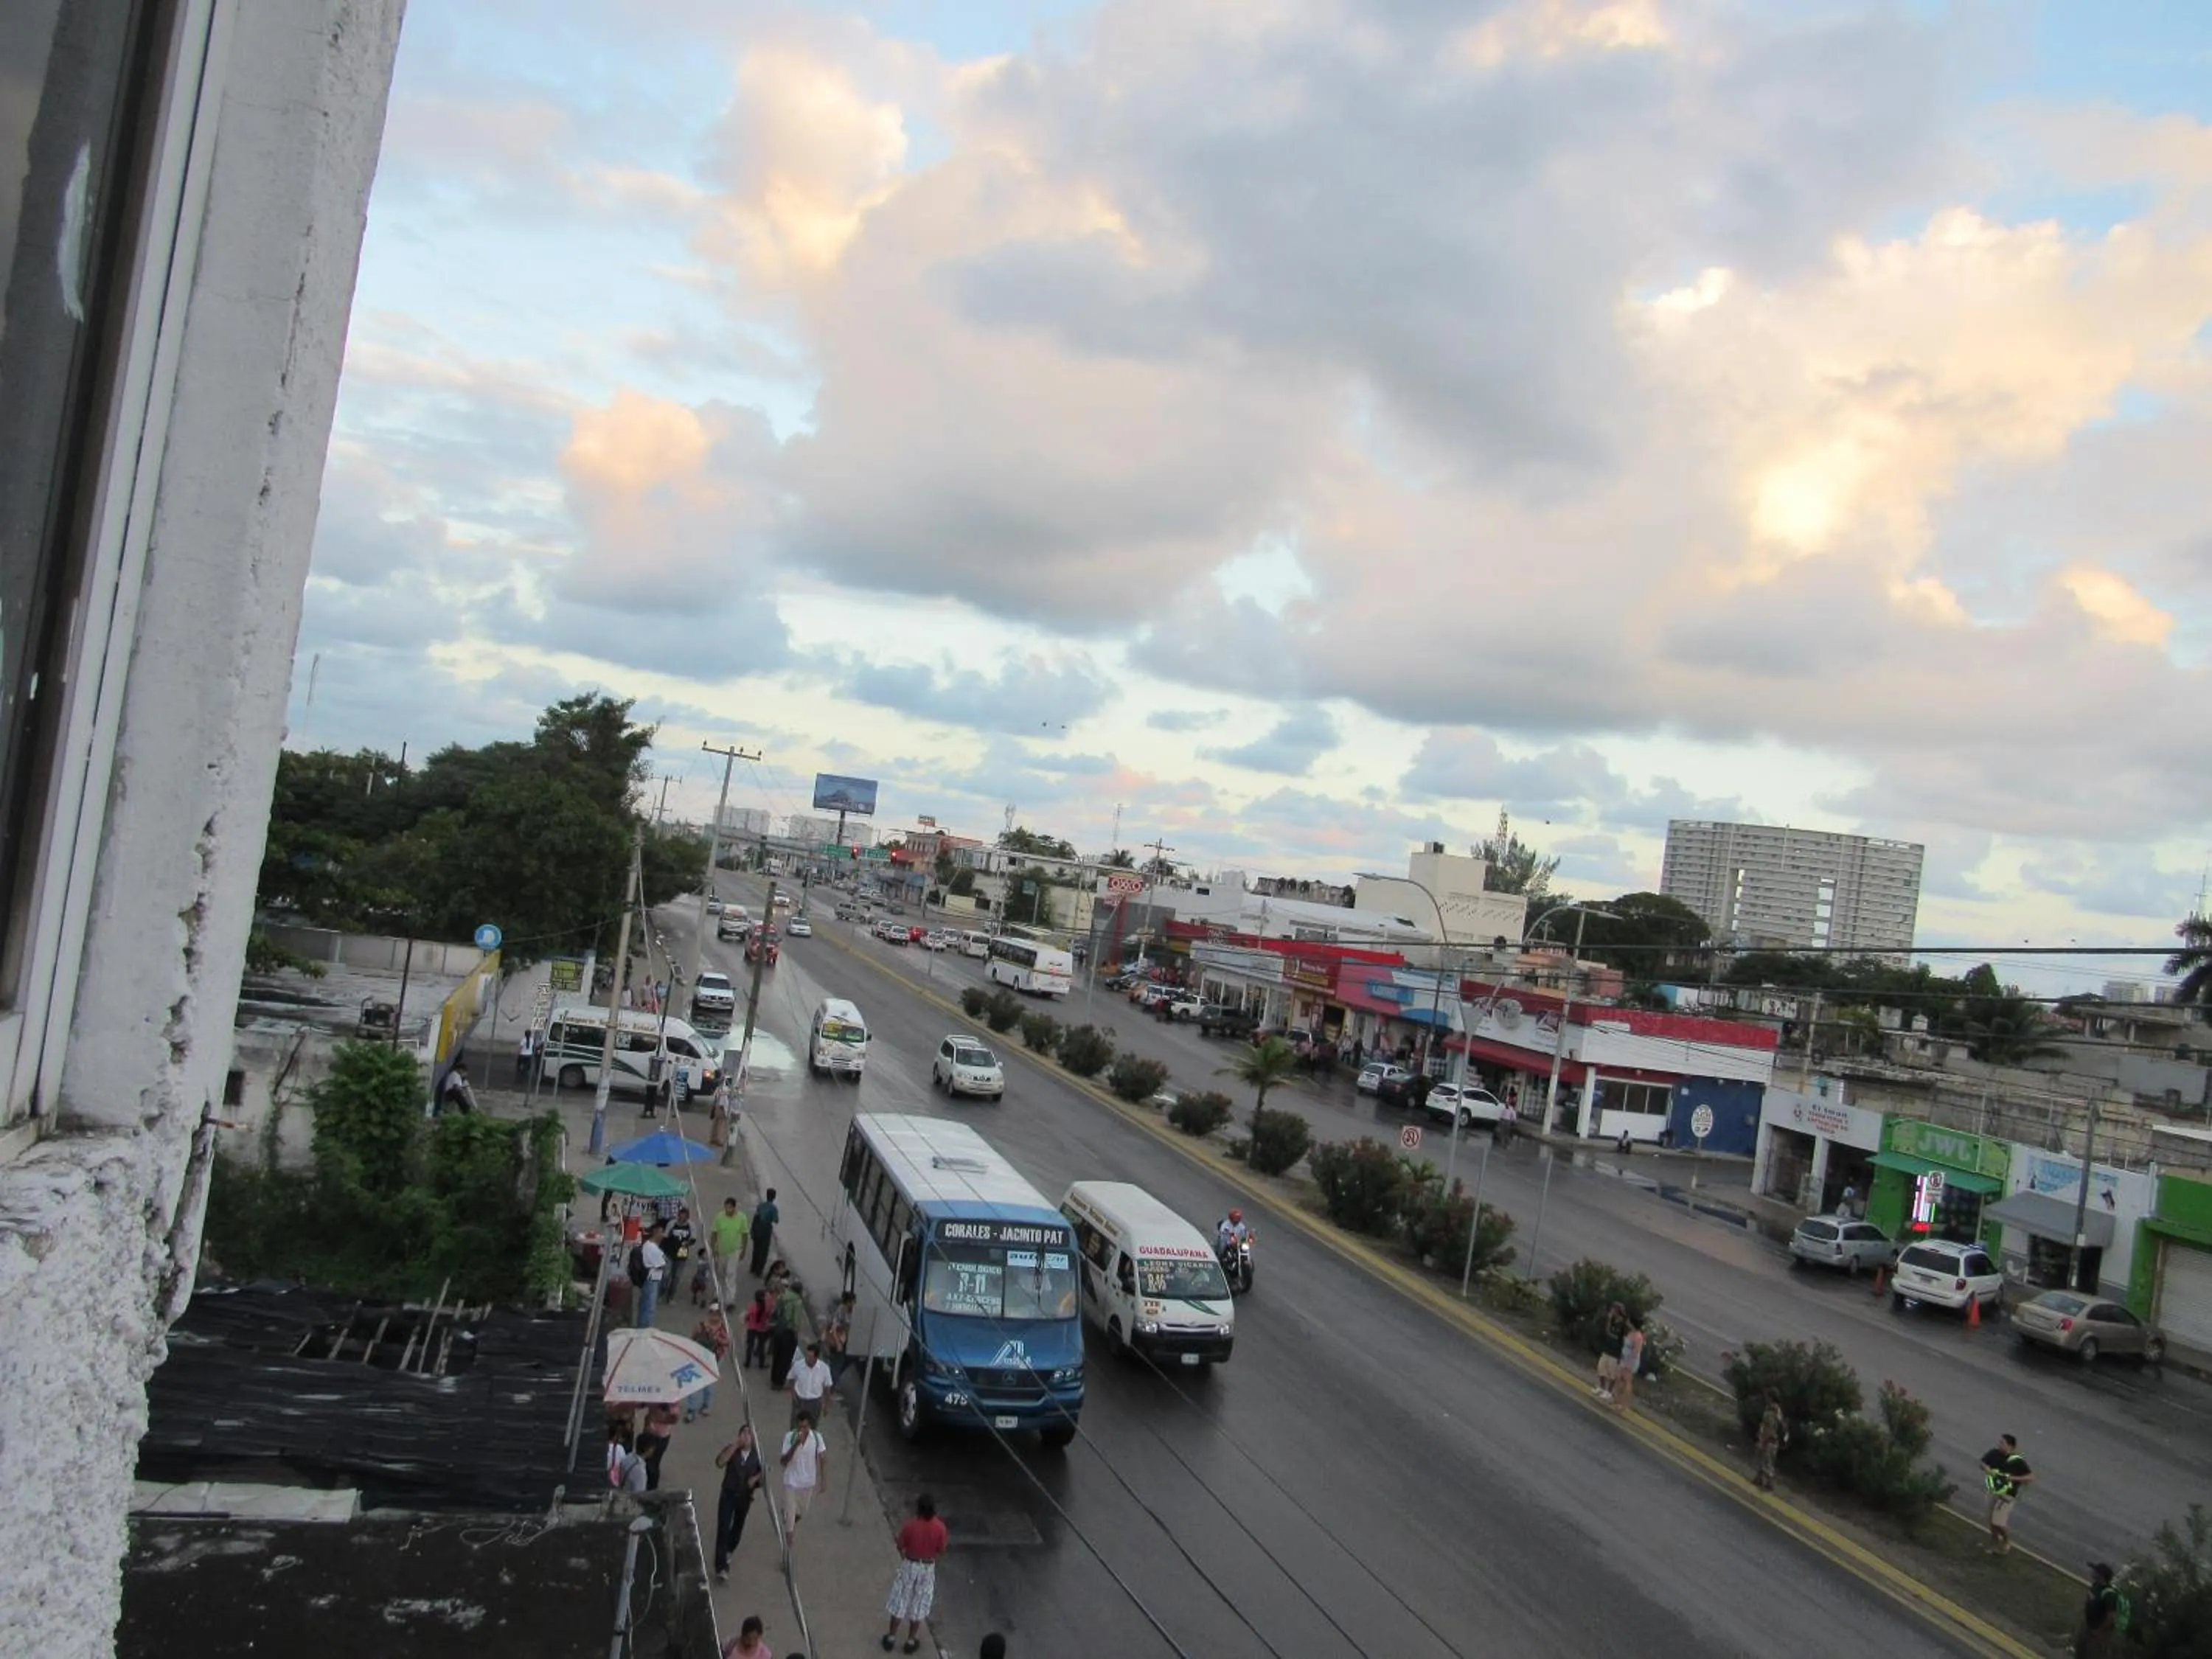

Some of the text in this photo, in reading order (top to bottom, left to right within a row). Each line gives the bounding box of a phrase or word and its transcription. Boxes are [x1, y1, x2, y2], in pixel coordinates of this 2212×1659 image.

[1110, 875, 1143, 891] OXXO
[945, 1223, 990, 1239] CORALES
[999, 1226, 1042, 1242] JACINTO
[1043, 1230, 1064, 1244] PAT
[1138, 1245, 1208, 1259] GUADALUPANA
[617, 1385, 661, 1394] TELMEX
